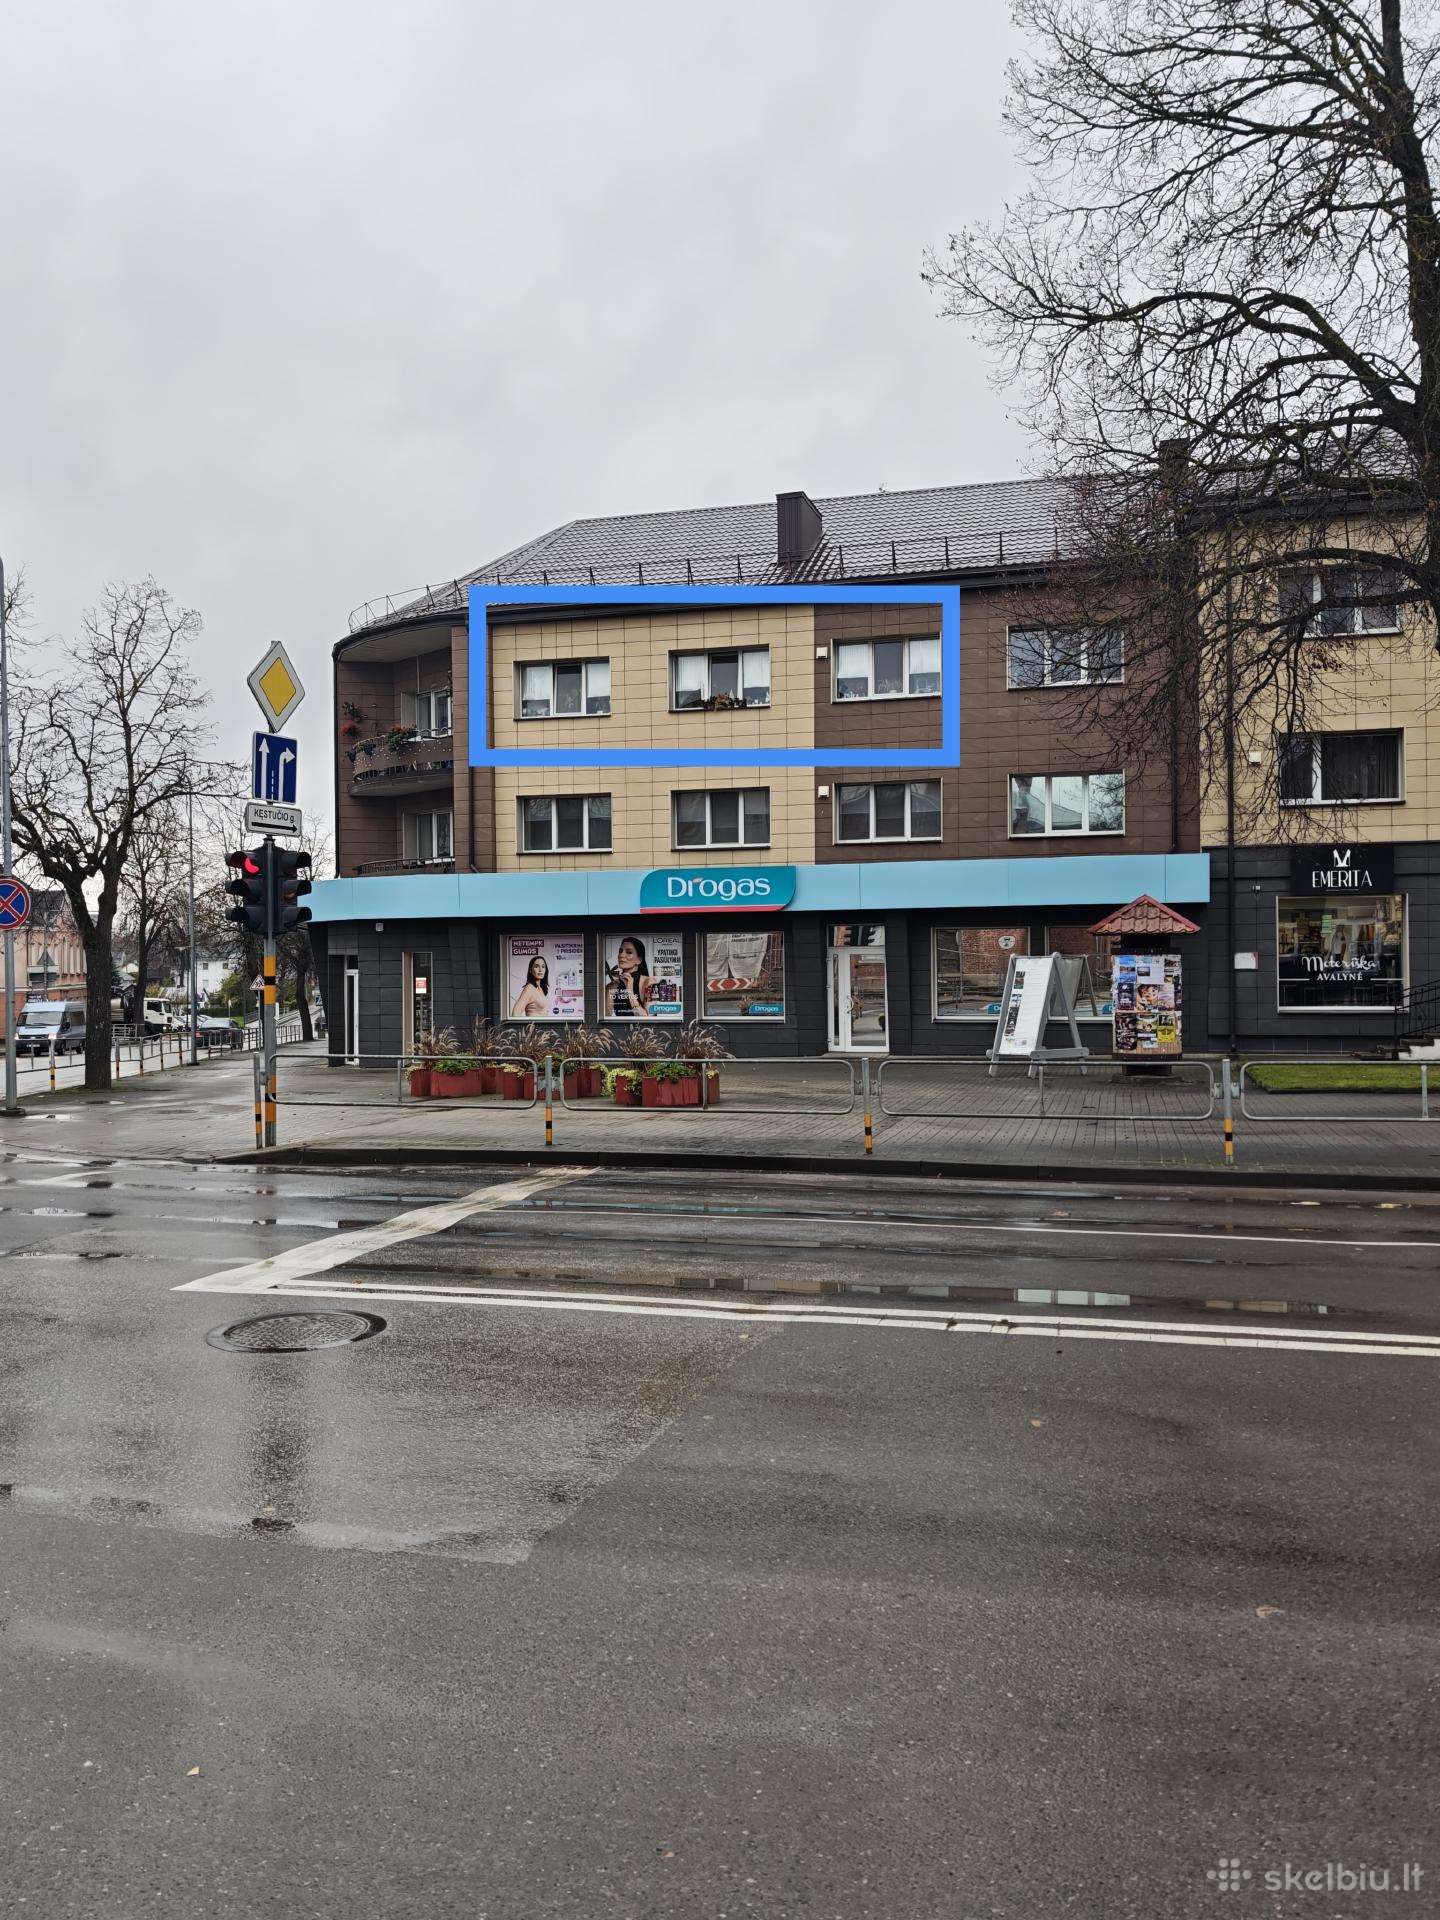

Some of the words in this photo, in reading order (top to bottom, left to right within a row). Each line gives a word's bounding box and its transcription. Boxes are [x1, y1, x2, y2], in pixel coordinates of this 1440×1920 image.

[254, 808, 289, 821] KĘSTUČIO
[1312, 869, 1373, 888] EMERITA
[667, 876, 771, 901] Drogas
[1301, 955, 1377, 971] Moteriška
[1316, 972, 1363, 981] AVALYNĖ
